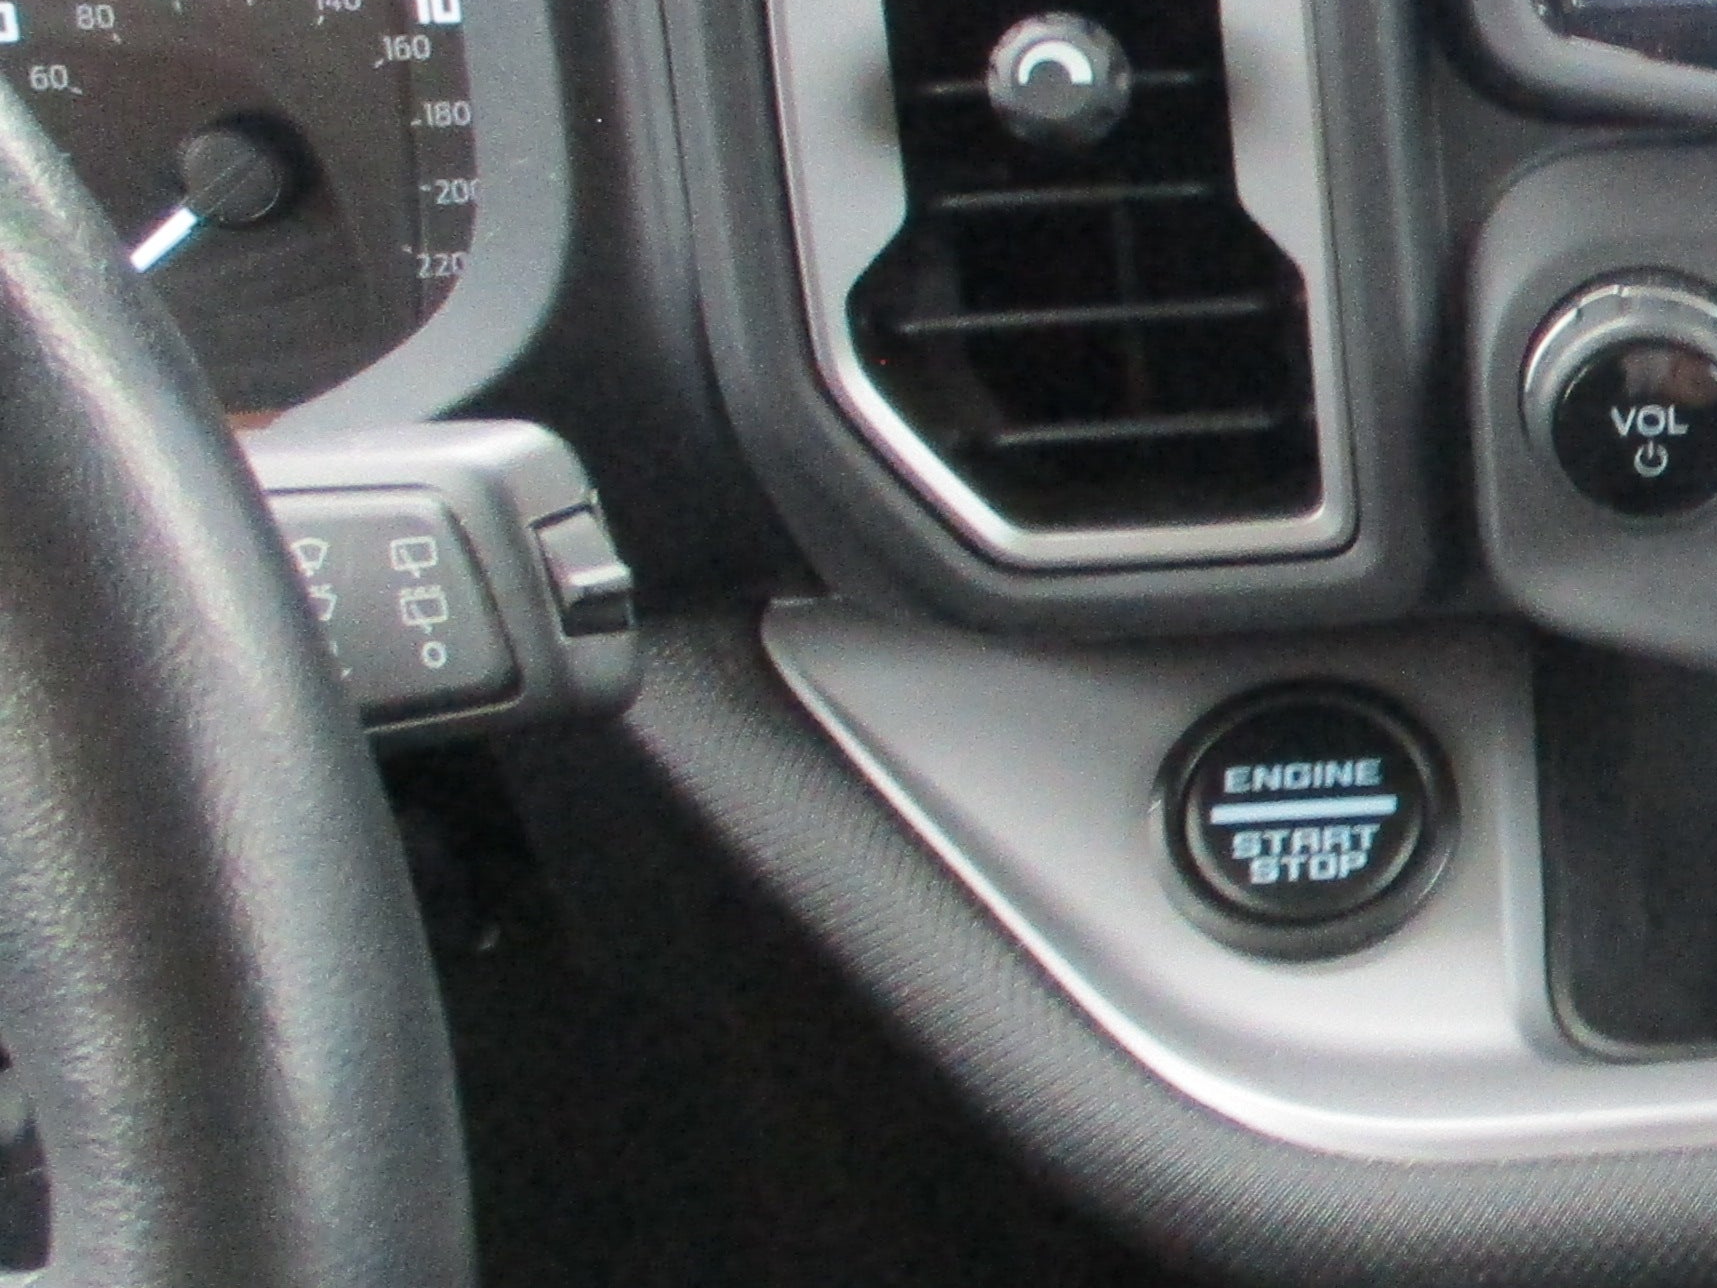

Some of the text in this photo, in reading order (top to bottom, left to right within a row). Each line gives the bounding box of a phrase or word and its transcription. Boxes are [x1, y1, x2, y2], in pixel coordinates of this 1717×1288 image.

[75, 3, 115, 31] 80
[382, 34, 432, 62] 160
[29, 64, 69, 92] 60
[422, 99, 472, 128] 180
[1610, 404, 1690, 437] VOL
[1224, 757, 1383, 794] ENGINE
[1231, 823, 1382, 860] START
[1249, 852, 1368, 885] STOP
